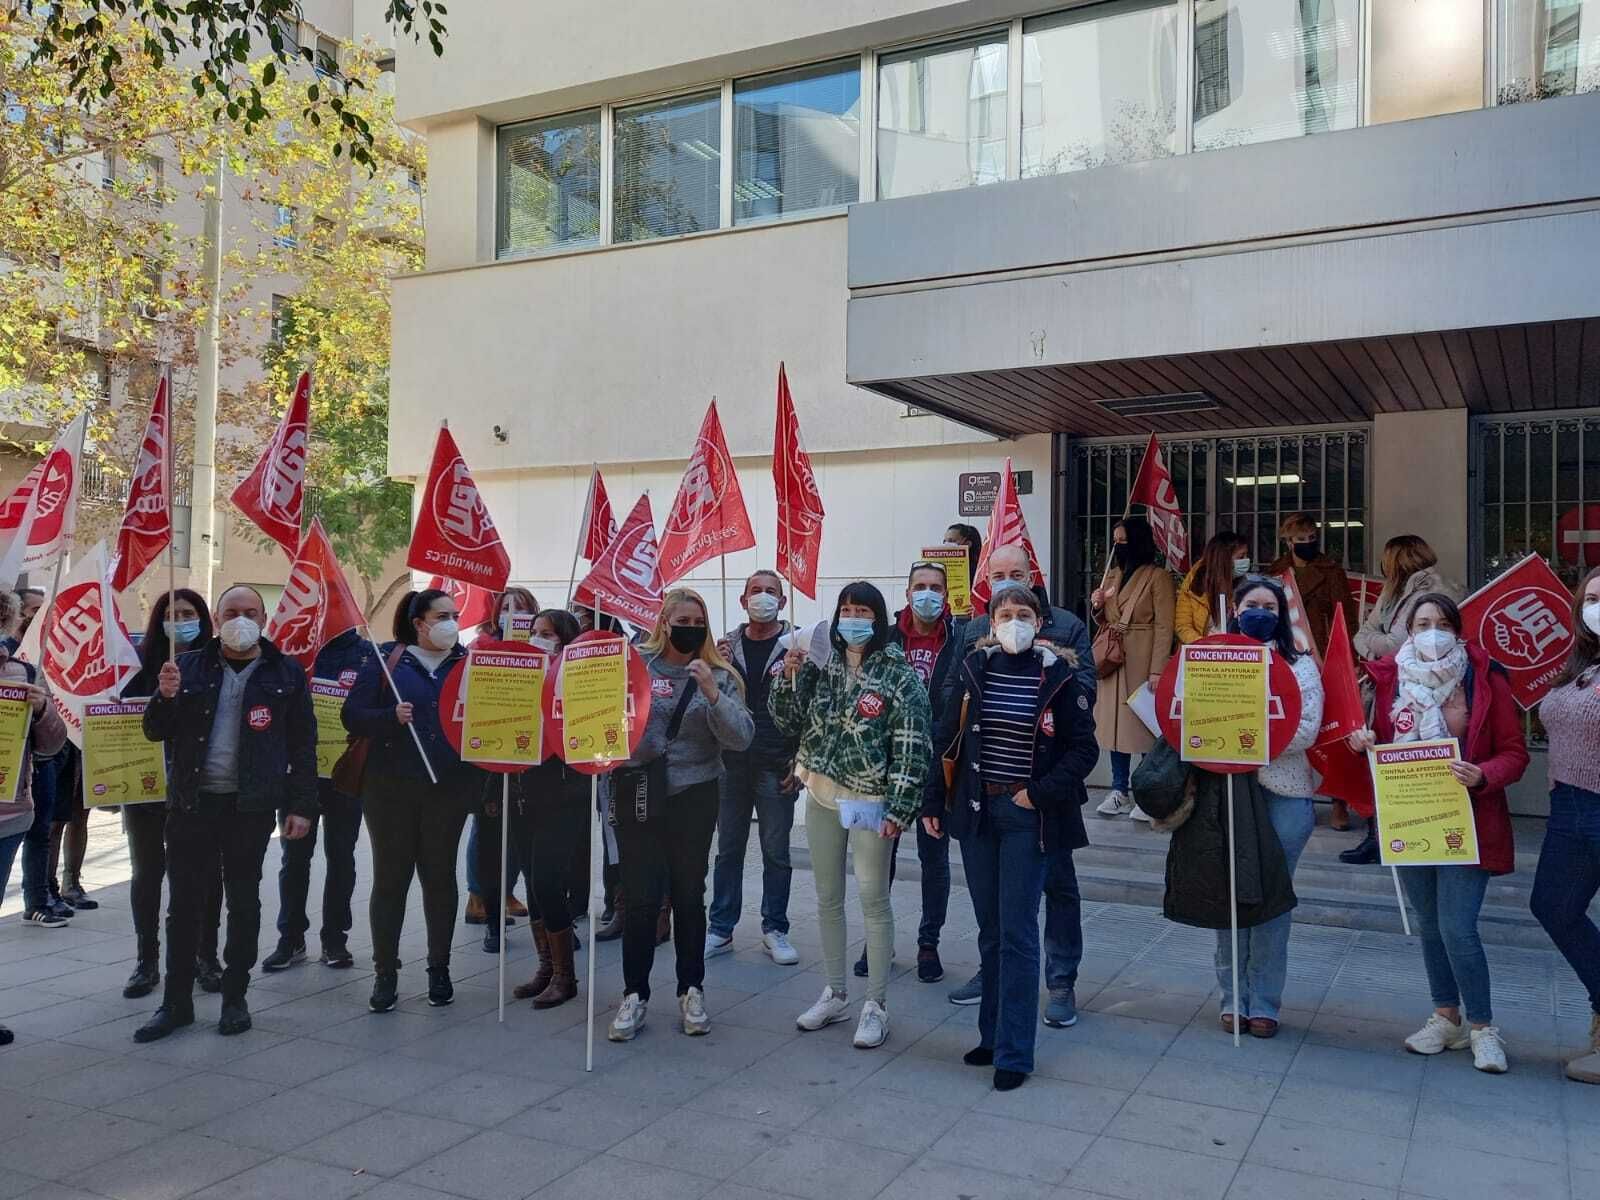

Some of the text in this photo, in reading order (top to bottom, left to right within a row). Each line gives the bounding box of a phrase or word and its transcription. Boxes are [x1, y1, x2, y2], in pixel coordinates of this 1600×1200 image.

[425, 549, 493, 577] www.ugt.es
[1501, 592, 1570, 655] UGT
[568, 643, 620, 660] CONCENTRACIÓN
[1189, 650, 1259, 661] CONCENTRACIÓN
[475, 655, 539, 667] CONCENTRACIÓN
[89, 703, 145, 715] CONCENTRACI
[1381, 747, 1451, 763] CONCENTRACIÓN
